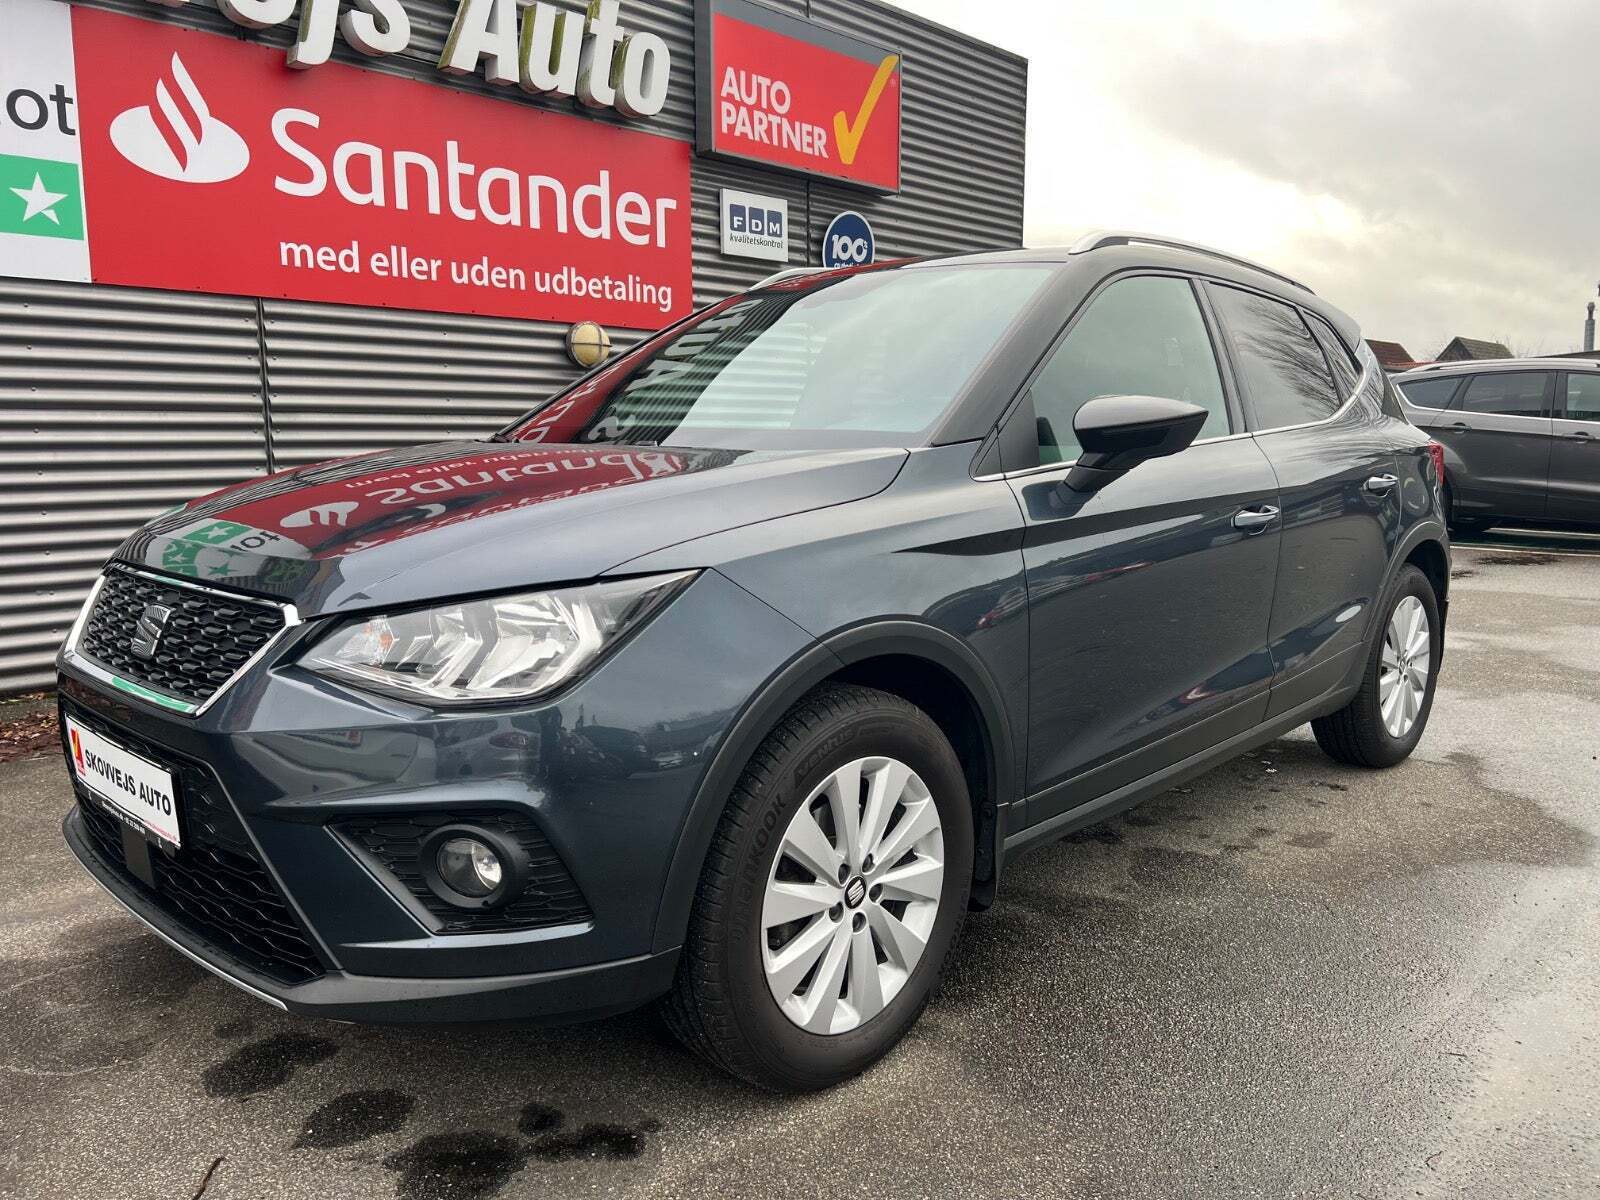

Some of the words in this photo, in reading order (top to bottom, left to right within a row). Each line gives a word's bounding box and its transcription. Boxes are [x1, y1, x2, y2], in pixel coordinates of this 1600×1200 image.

[445, 0, 671, 116] Auto
[721, 66, 791, 114] AUTO
[721, 101, 829, 158] PARTNER
[271, 108, 677, 248] Santander
[733, 215, 781, 235] FDM
[279, 240, 360, 273] med
[370, 245, 442, 281] eller
[451, 256, 526, 290] uden
[535, 266, 673, 313] udbetaling
[85, 749, 136, 795] SKOVVEJS
[140, 782, 171, 816] AUTO
